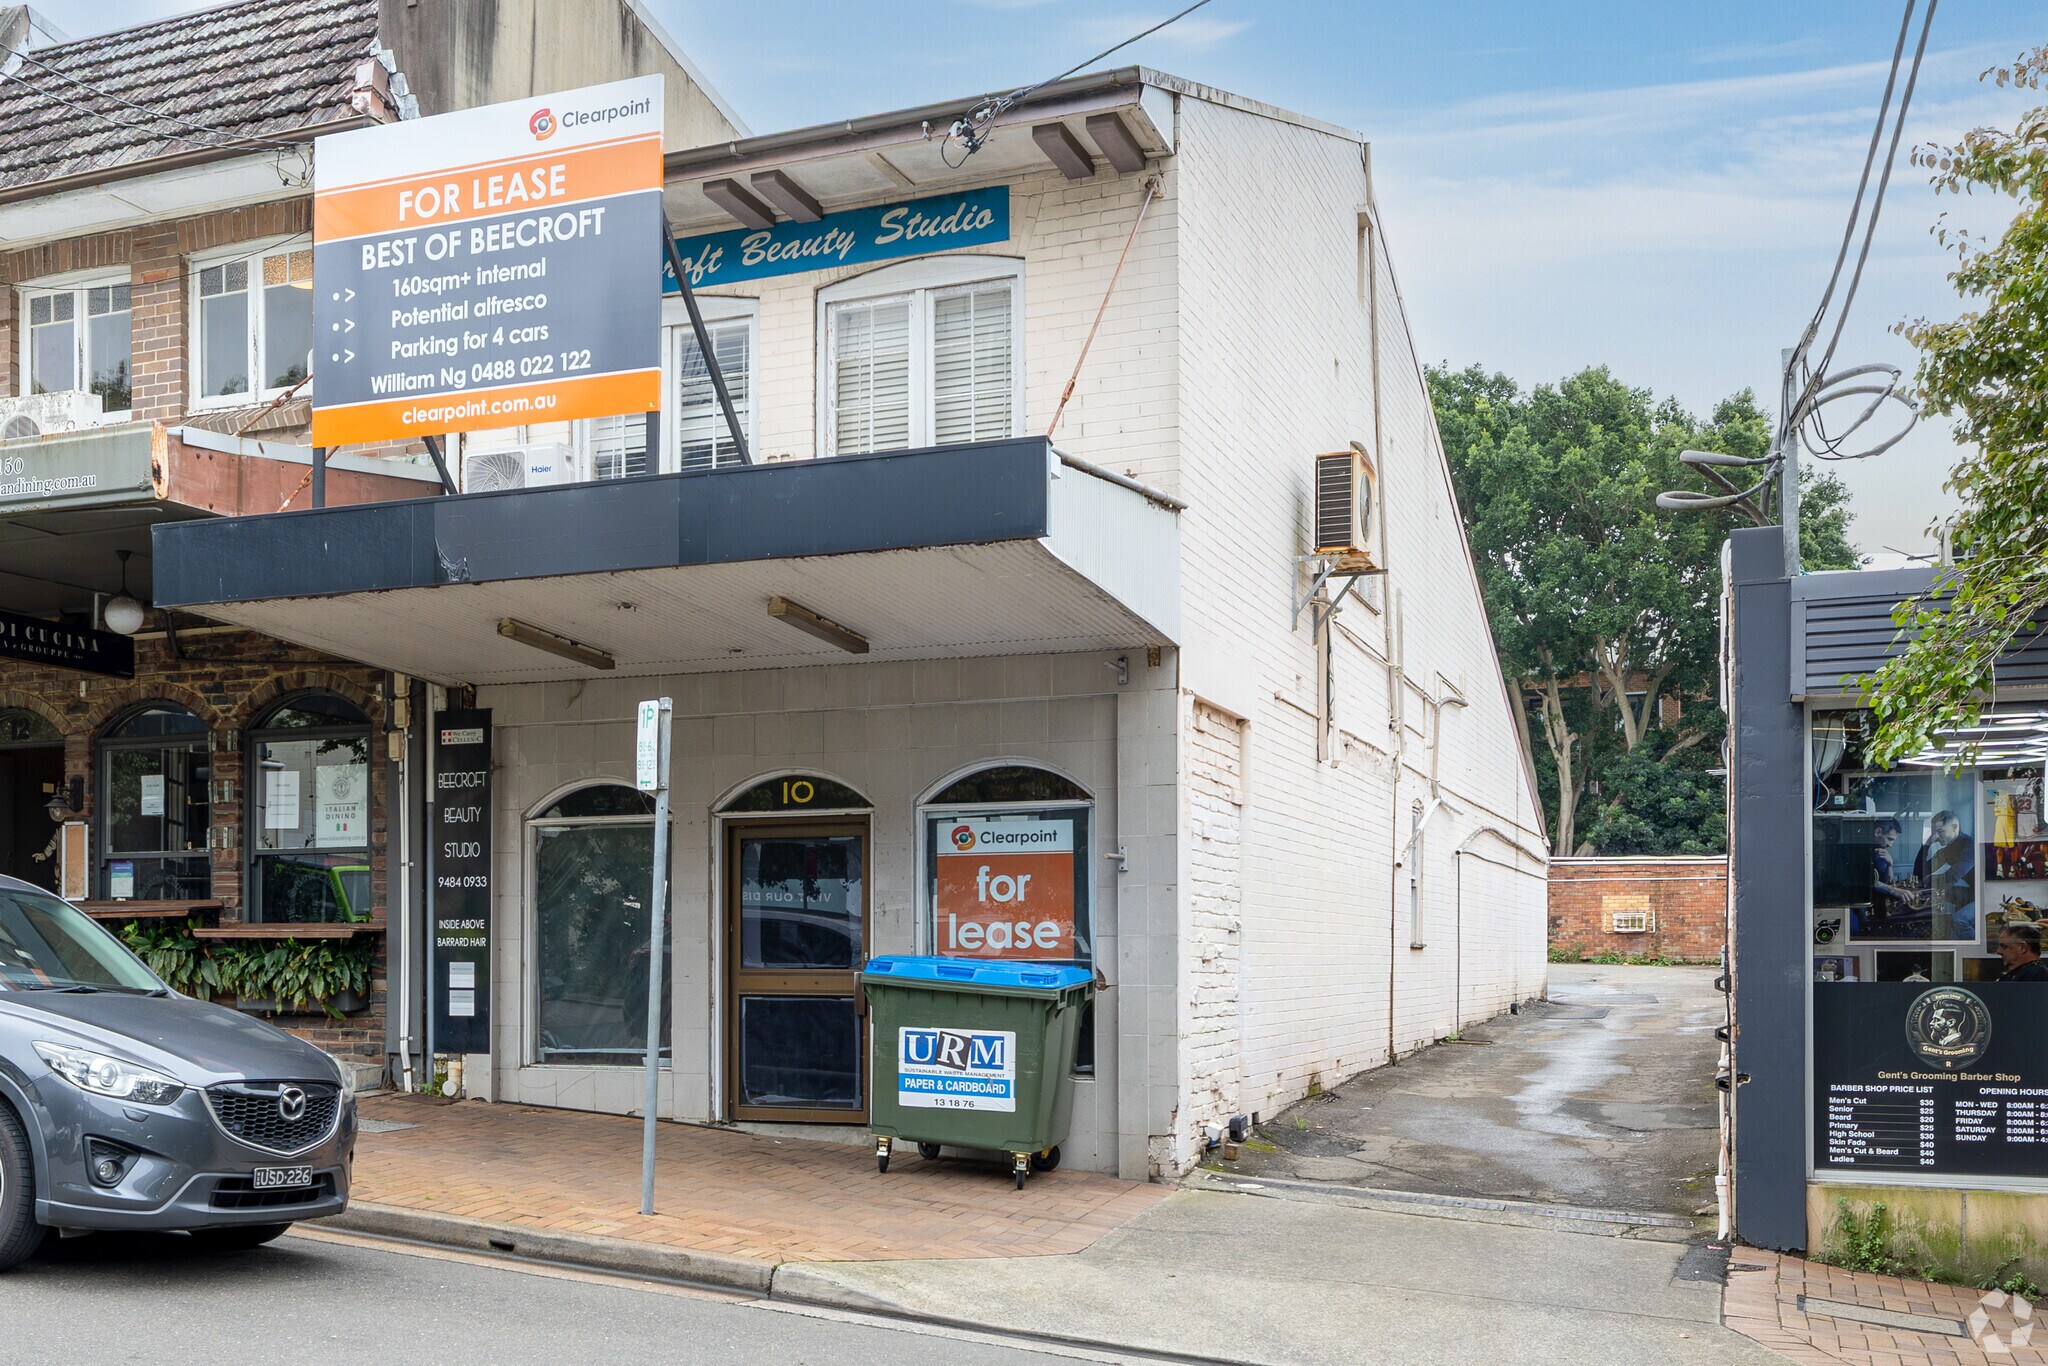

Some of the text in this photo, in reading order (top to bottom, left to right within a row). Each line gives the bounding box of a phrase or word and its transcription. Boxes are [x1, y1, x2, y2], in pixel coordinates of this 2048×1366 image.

[562, 97, 651, 128] Clearpoint
[399, 164, 566, 222] FOR LEASE
[361, 207, 606, 271] BEST OF BEECROFT
[661, 202, 995, 285] roft Beauty Studio
[392, 257, 547, 298] 160sqm+ internal
[391, 293, 548, 328] Potential alfresco
[391, 324, 549, 359] Parking for 4 cars
[371, 349, 591, 394] William Ng 0488 022 122
[401, 394, 557, 425] clearpoint.com.au
[531, 465, 552, 474] Haier
[0, 474, 96, 497] andining.com.au
[25, 626, 99, 652] CUCINA
[642, 708, 654, 728] 1P
[462, 730, 477, 738] Carry
[438, 771, 487, 789] BEECROFT
[783, 781, 814, 804] 10
[2018, 799, 2032, 812] 23
[444, 807, 481, 823] BEAUTY
[980, 830, 1058, 846] Clearpoint
[444, 842, 481, 858] STUDIO
[438, 876, 487, 888] 9484 0933
[976, 865, 1031, 902] for
[439, 919, 485, 929] INSIDE ABOVE
[949, 913, 1061, 949] lease
[437, 937, 486, 947] BARRARD HAIR
[906, 1033, 1004, 1067] URM
[1923, 1046, 1974, 1056] Gent's Grooming
[1878, 1071, 2021, 1083] Gent's Grooming Barber Shop
[905, 1078, 1006, 1094] PAPER & CARDBOARD
[1831, 1084, 1863, 1092] BARBER
[1865, 1085, 1888, 1093] SHOP
[1979, 1087, 2018, 1095] OPENING
[934, 1098, 975, 1108] 13 18 76
[1829, 1113, 1852, 1121] Beard
[1955, 1109, 1997, 1117] THURSDAY
[2006, 1110, 2034, 1118] 8:00AM
[1829, 1122, 1934, 1132] Primary $25
[1829, 1130, 1847, 1138] High
[2006, 1127, 2034, 1135] 8:00AM
[1829, 1138, 1846, 1146] Skin
[1955, 1134, 1987, 1142] SUNDAY
[1830, 1155, 1855, 1163] Ladies
[1920, 1149, 1935, 1157] $40
